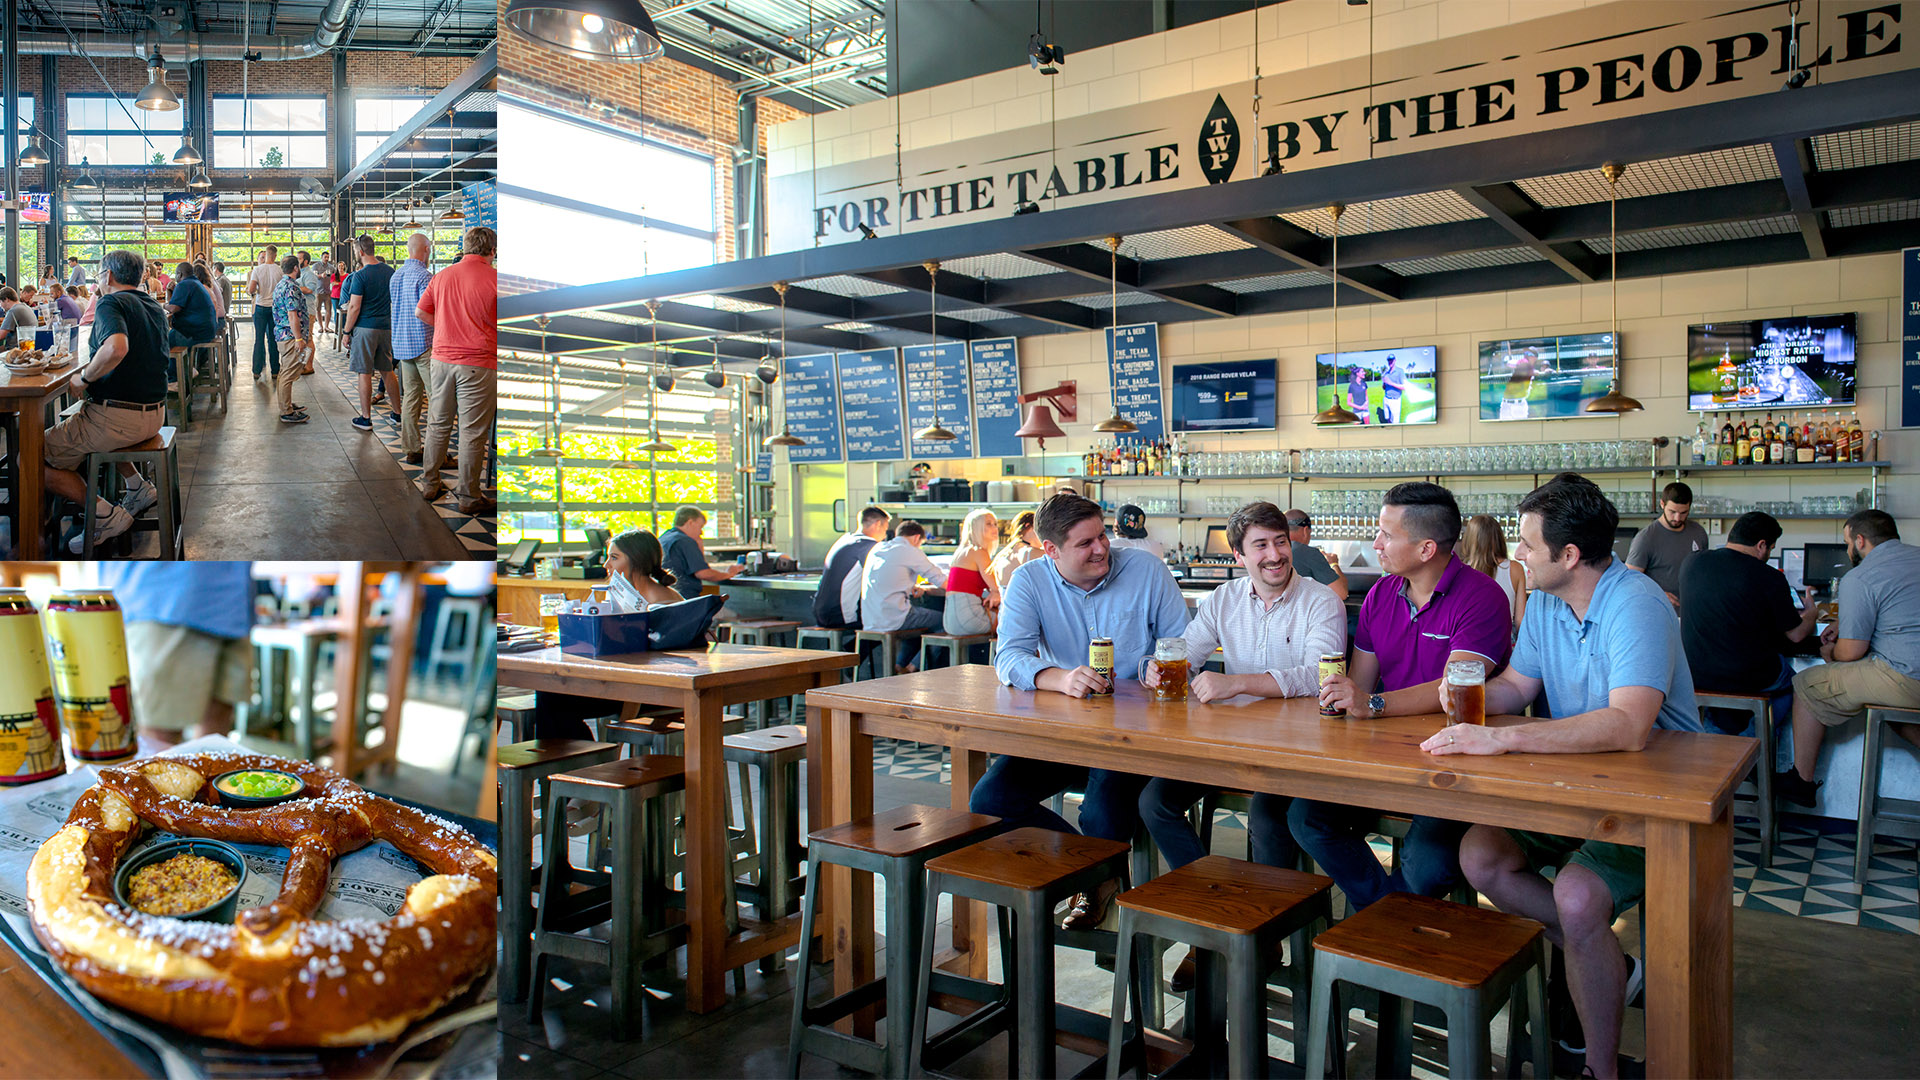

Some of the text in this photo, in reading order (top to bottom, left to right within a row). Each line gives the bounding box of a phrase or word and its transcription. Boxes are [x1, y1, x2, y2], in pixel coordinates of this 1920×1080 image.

[1261, 4, 1902, 164] BY THE PEOPLE
[813, 143, 1179, 237] FOR THE TABLE
[1132, 327, 1146, 335] BEER
[1780, 340, 1815, 348] WORLD'S
[1755, 345, 1821, 357] HIGHEST RATED
[1123, 360, 1154, 369] SOUTHERNER
[1767, 355, 1808, 365] BOURBON
